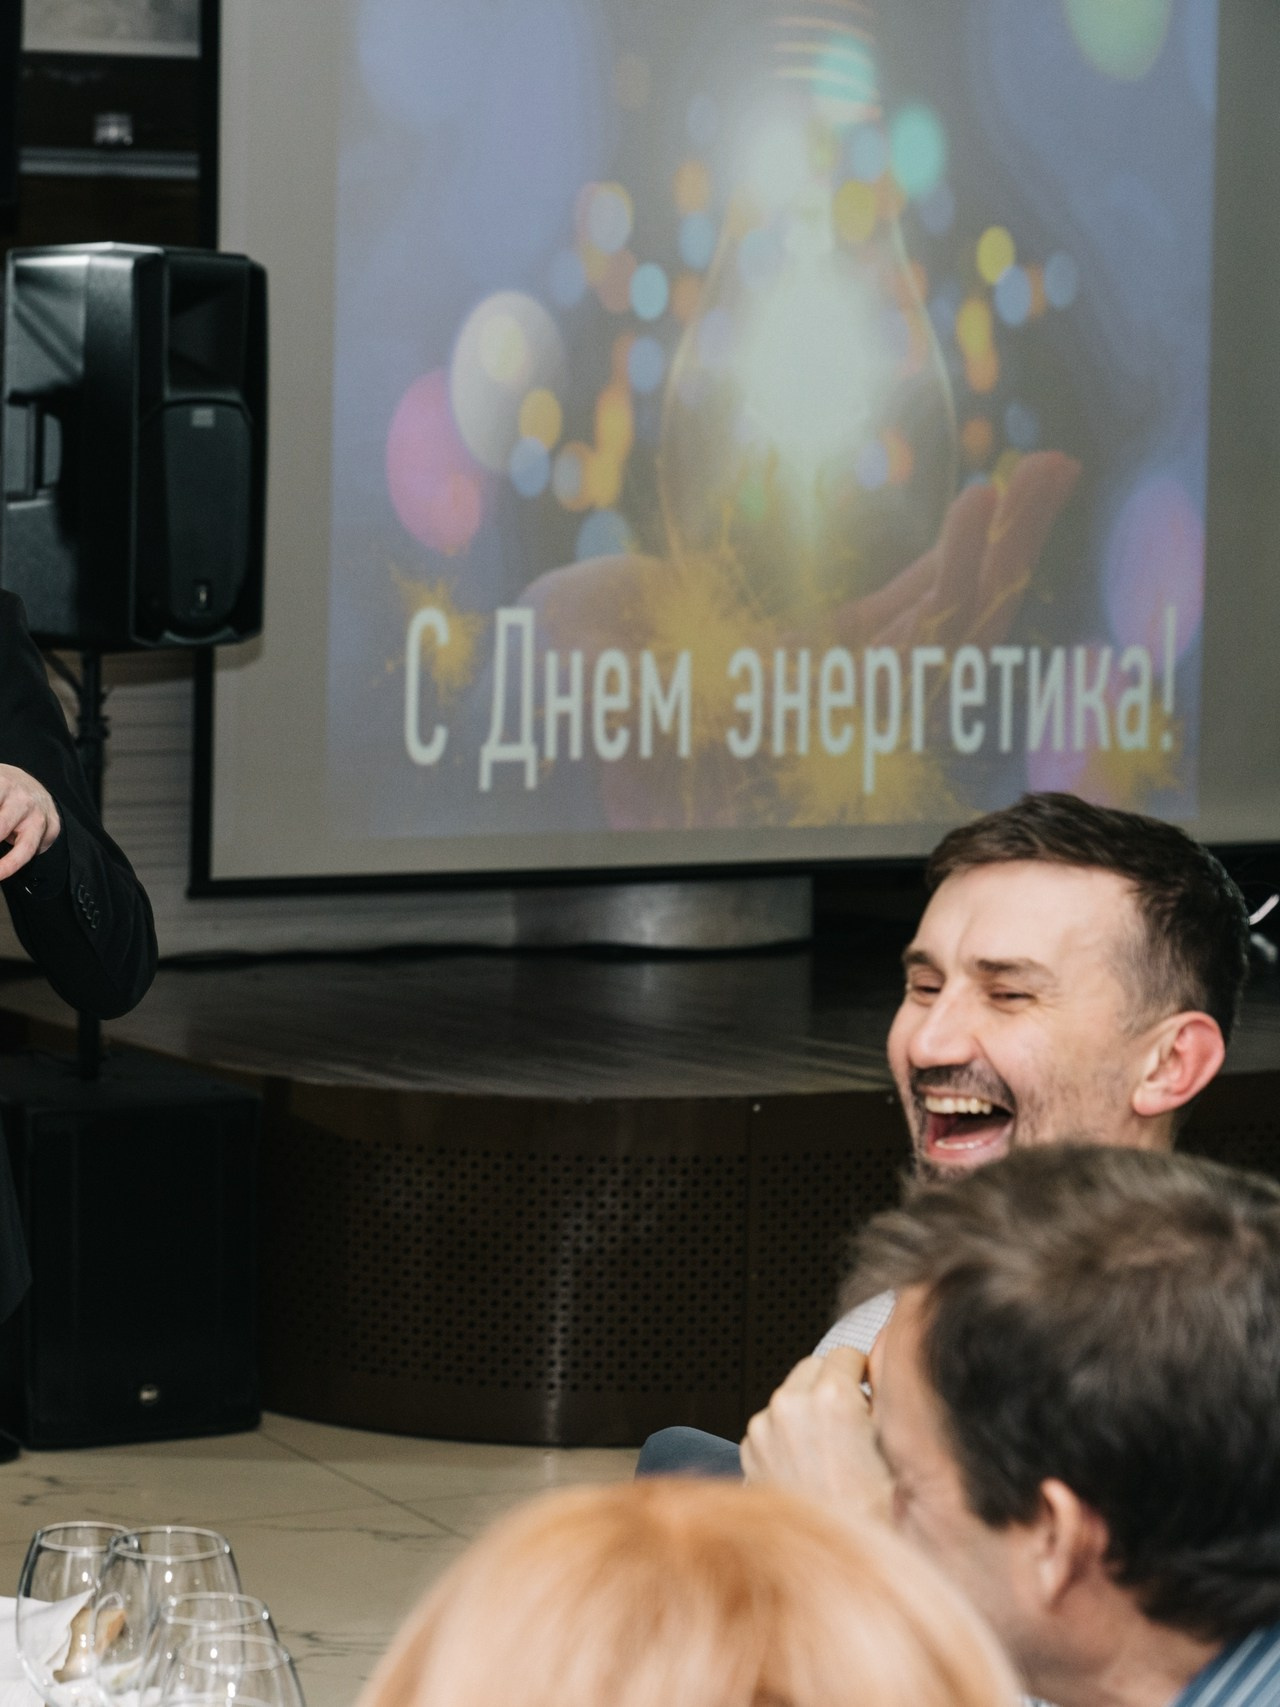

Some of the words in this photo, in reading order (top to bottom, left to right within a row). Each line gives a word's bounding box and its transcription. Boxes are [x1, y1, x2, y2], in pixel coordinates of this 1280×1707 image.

[404, 607, 451, 766] С
[478, 606, 693, 793] Днем
[726, 604, 1179, 795] энергетика!
